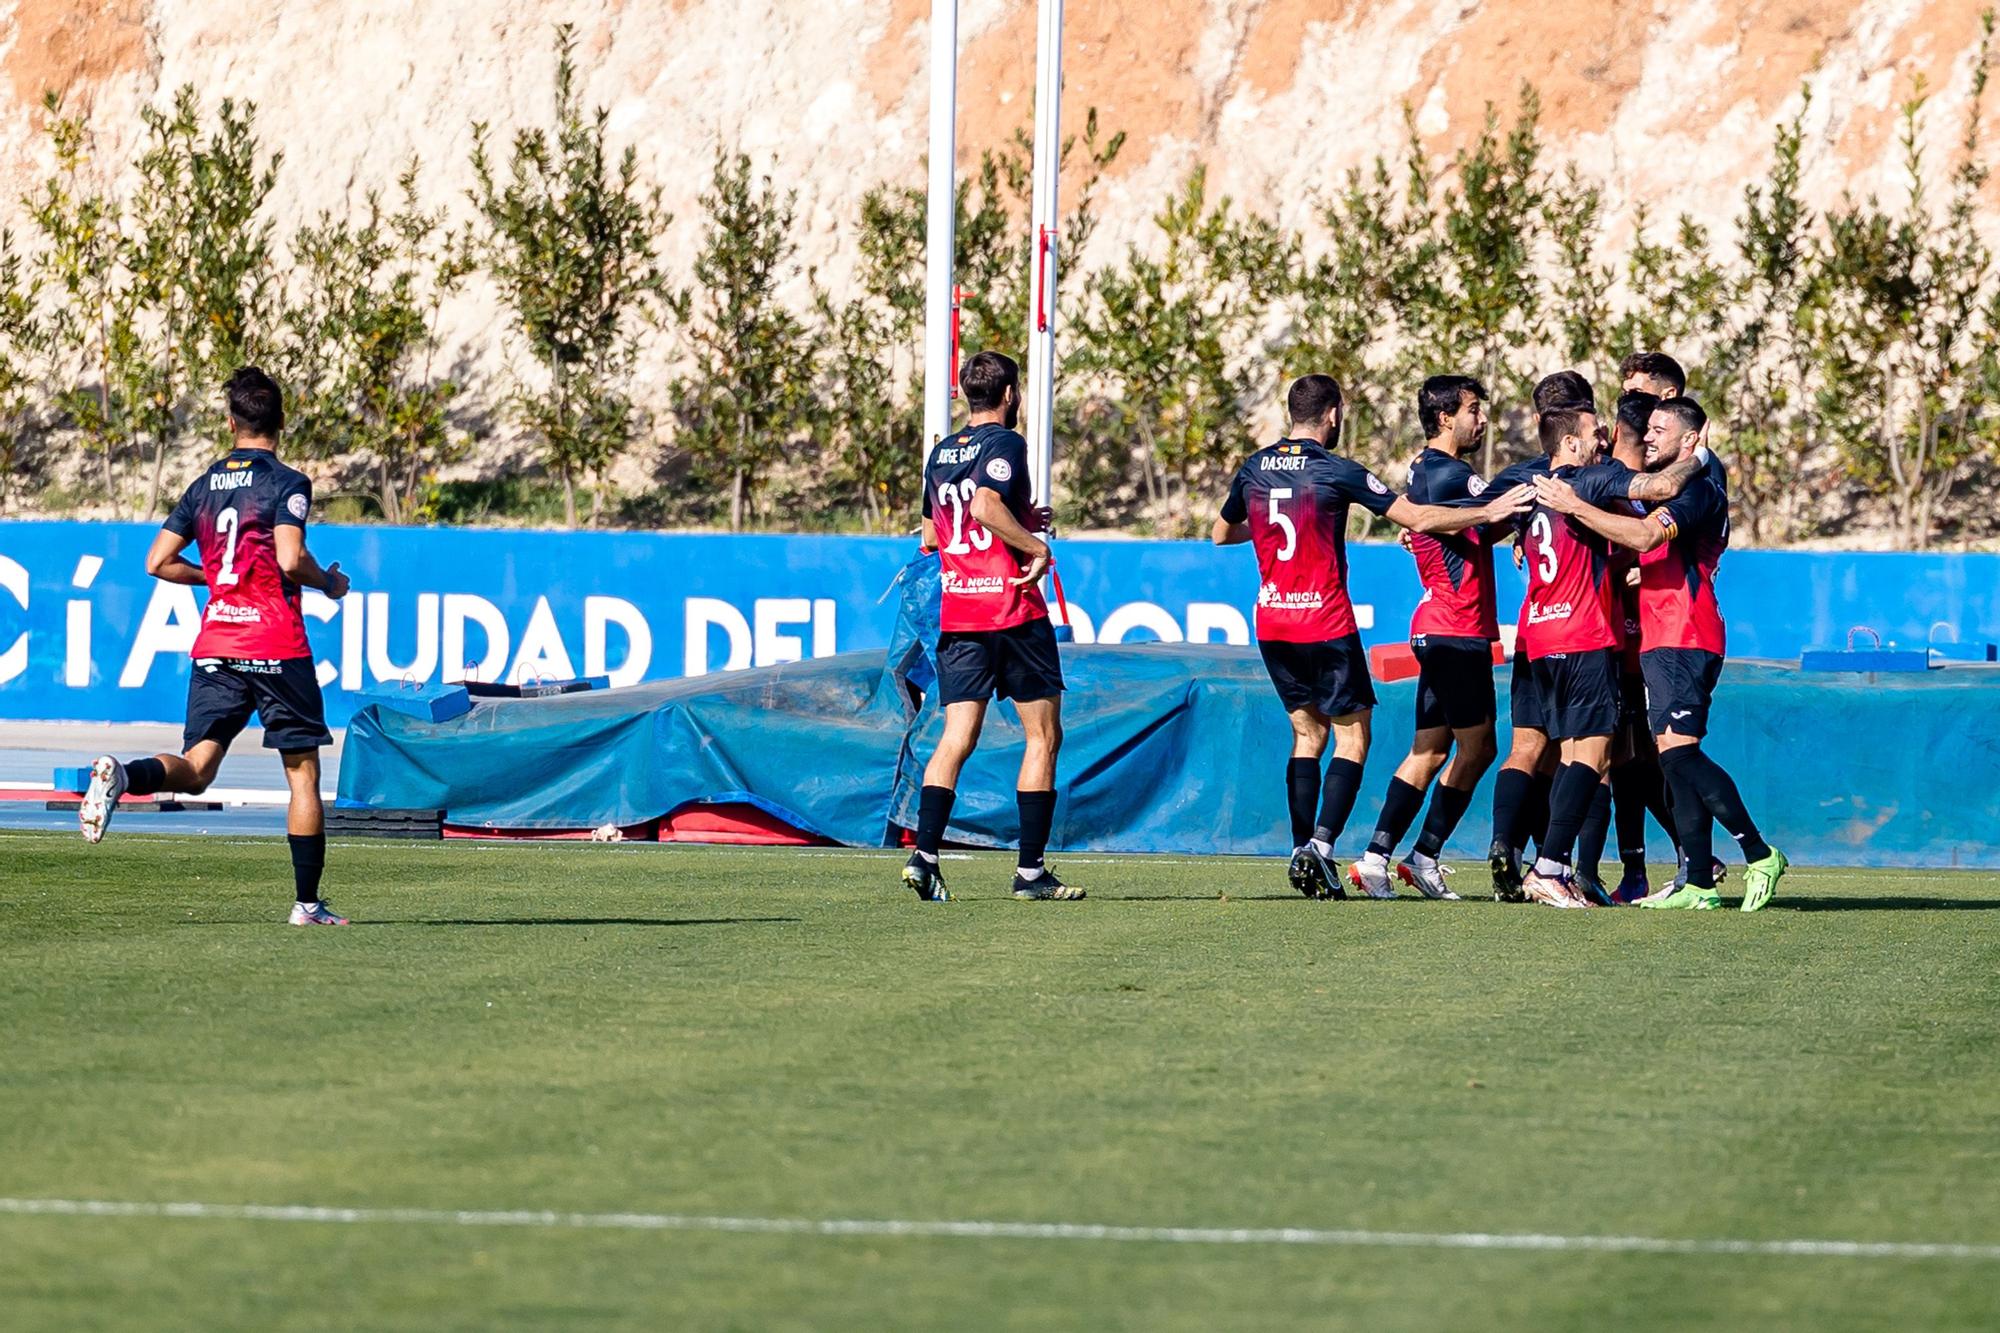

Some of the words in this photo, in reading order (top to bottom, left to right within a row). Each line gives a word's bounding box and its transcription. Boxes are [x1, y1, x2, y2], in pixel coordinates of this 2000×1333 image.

[210, 471, 254, 491] ROMERA
[1260, 456, 1308, 471] DASQUET
[215, 507, 239, 585] 2
[938, 478, 992, 555] 23
[1269, 488, 1297, 562] 5
[1532, 512, 1558, 583] 3
